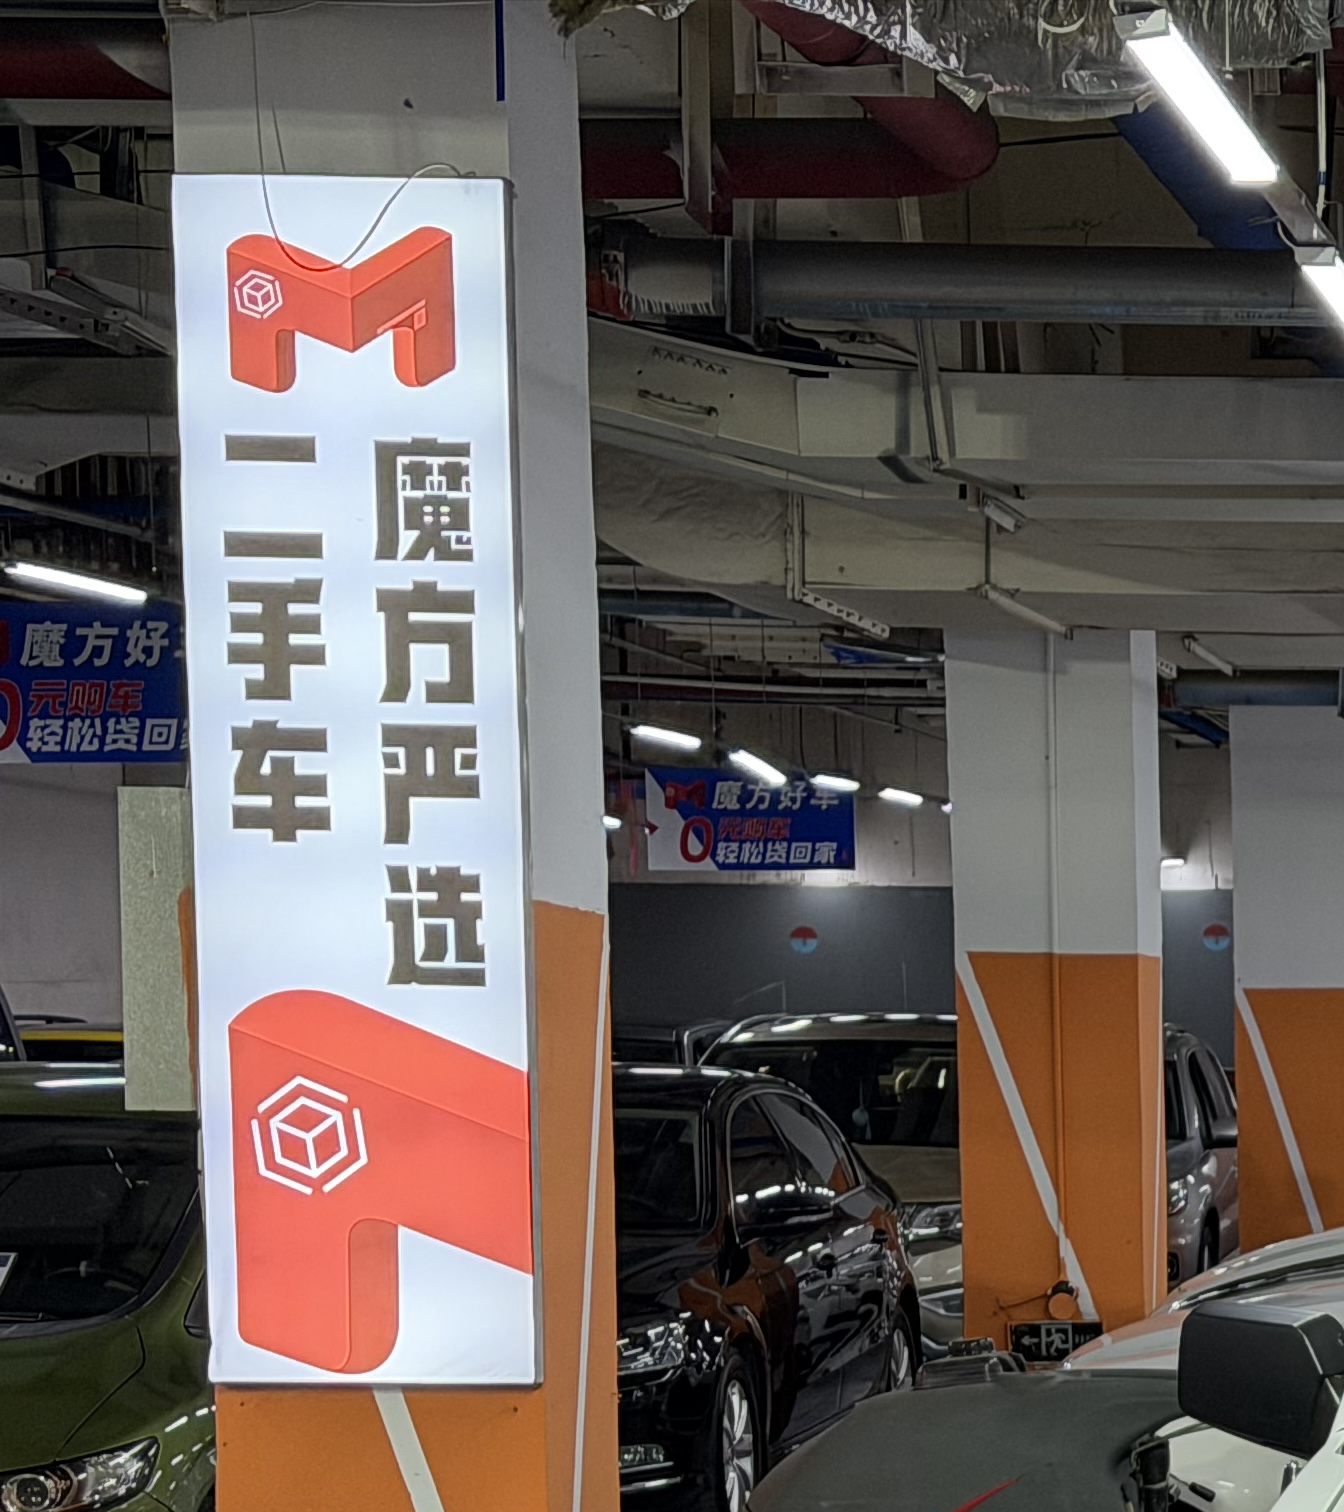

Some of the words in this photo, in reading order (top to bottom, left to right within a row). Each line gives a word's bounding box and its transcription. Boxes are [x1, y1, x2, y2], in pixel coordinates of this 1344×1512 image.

[19, 621, 186, 667] 魔方好
[223, 433, 332, 843] 二手车
[26, 717, 190, 752] 轻松贷回
[373, 436, 487, 987] 魔方严选
[715, 842, 838, 864] 轻松贷回家
